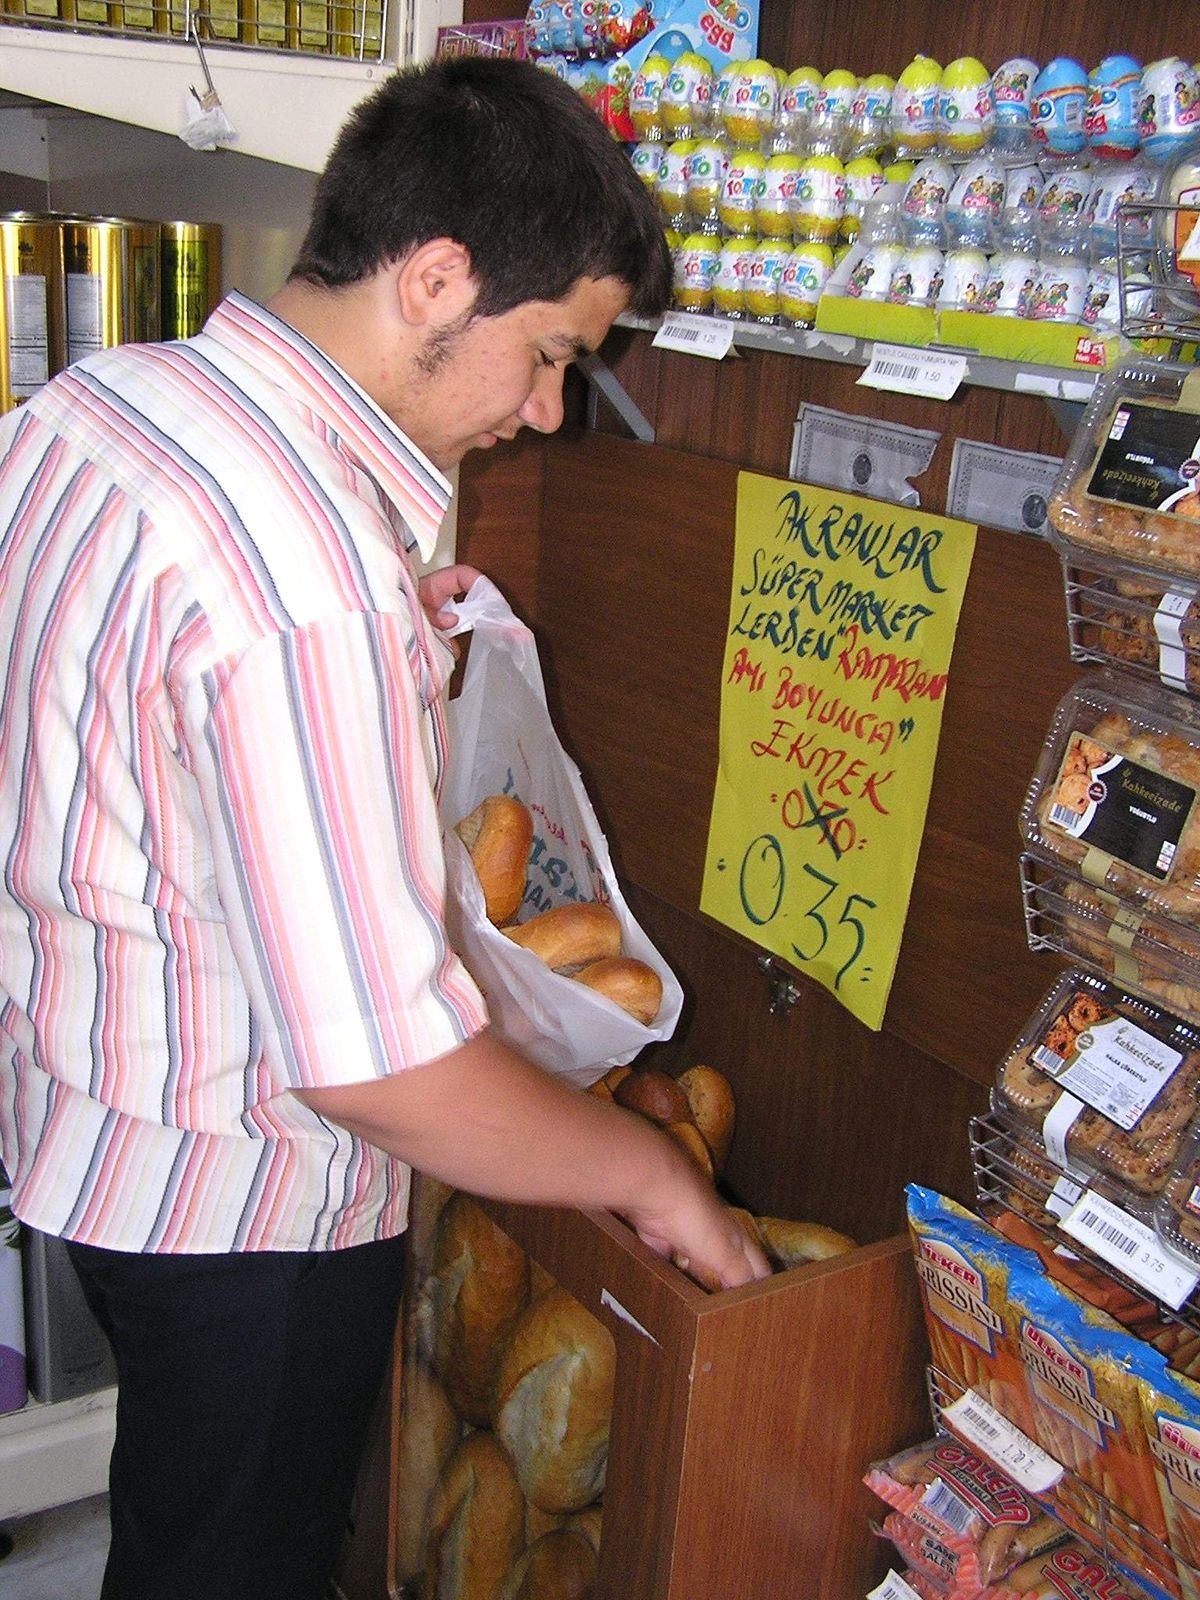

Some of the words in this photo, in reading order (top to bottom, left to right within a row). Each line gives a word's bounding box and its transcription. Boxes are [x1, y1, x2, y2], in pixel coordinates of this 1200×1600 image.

[700, 14, 734, 52] egg
[776, 490, 947, 593] AKRANLAR
[752, 719, 896, 816] EKMEK
[1140, 1252, 1165, 1273] 3.75
[935, 1447, 1031, 1525] GALETA
